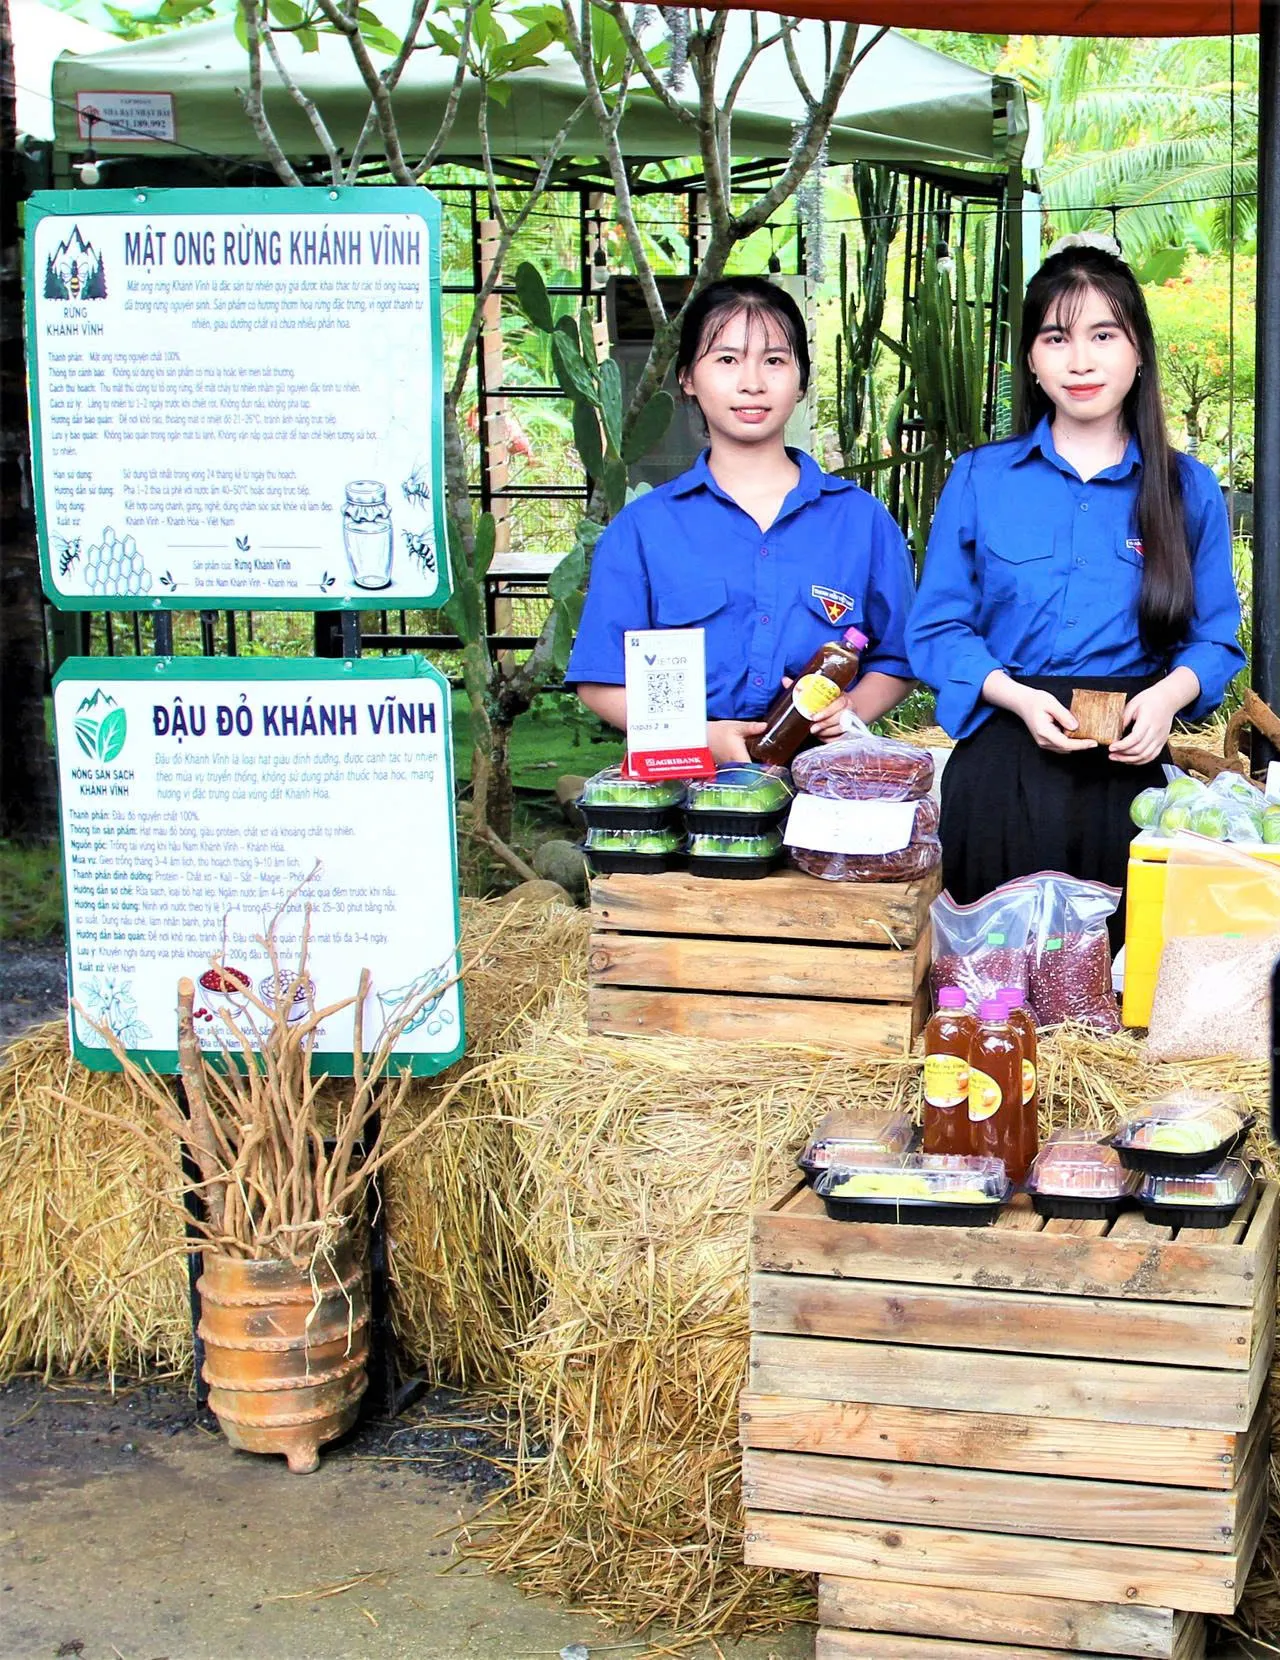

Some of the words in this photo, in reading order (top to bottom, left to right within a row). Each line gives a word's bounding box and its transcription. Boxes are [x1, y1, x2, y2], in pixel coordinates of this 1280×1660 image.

[125, 224, 166, 274] MẬT
[175, 231, 215, 266] ONG
[224, 223, 281, 266] RỪNG
[290, 224, 360, 265] KHÁNH
[370, 224, 420, 265] VĨNH
[153, 696, 205, 743] ĐẬU
[216, 693, 253, 736] ĐỎ
[264, 695, 356, 736] KHÁNH
[368, 695, 436, 735] VĨNH
